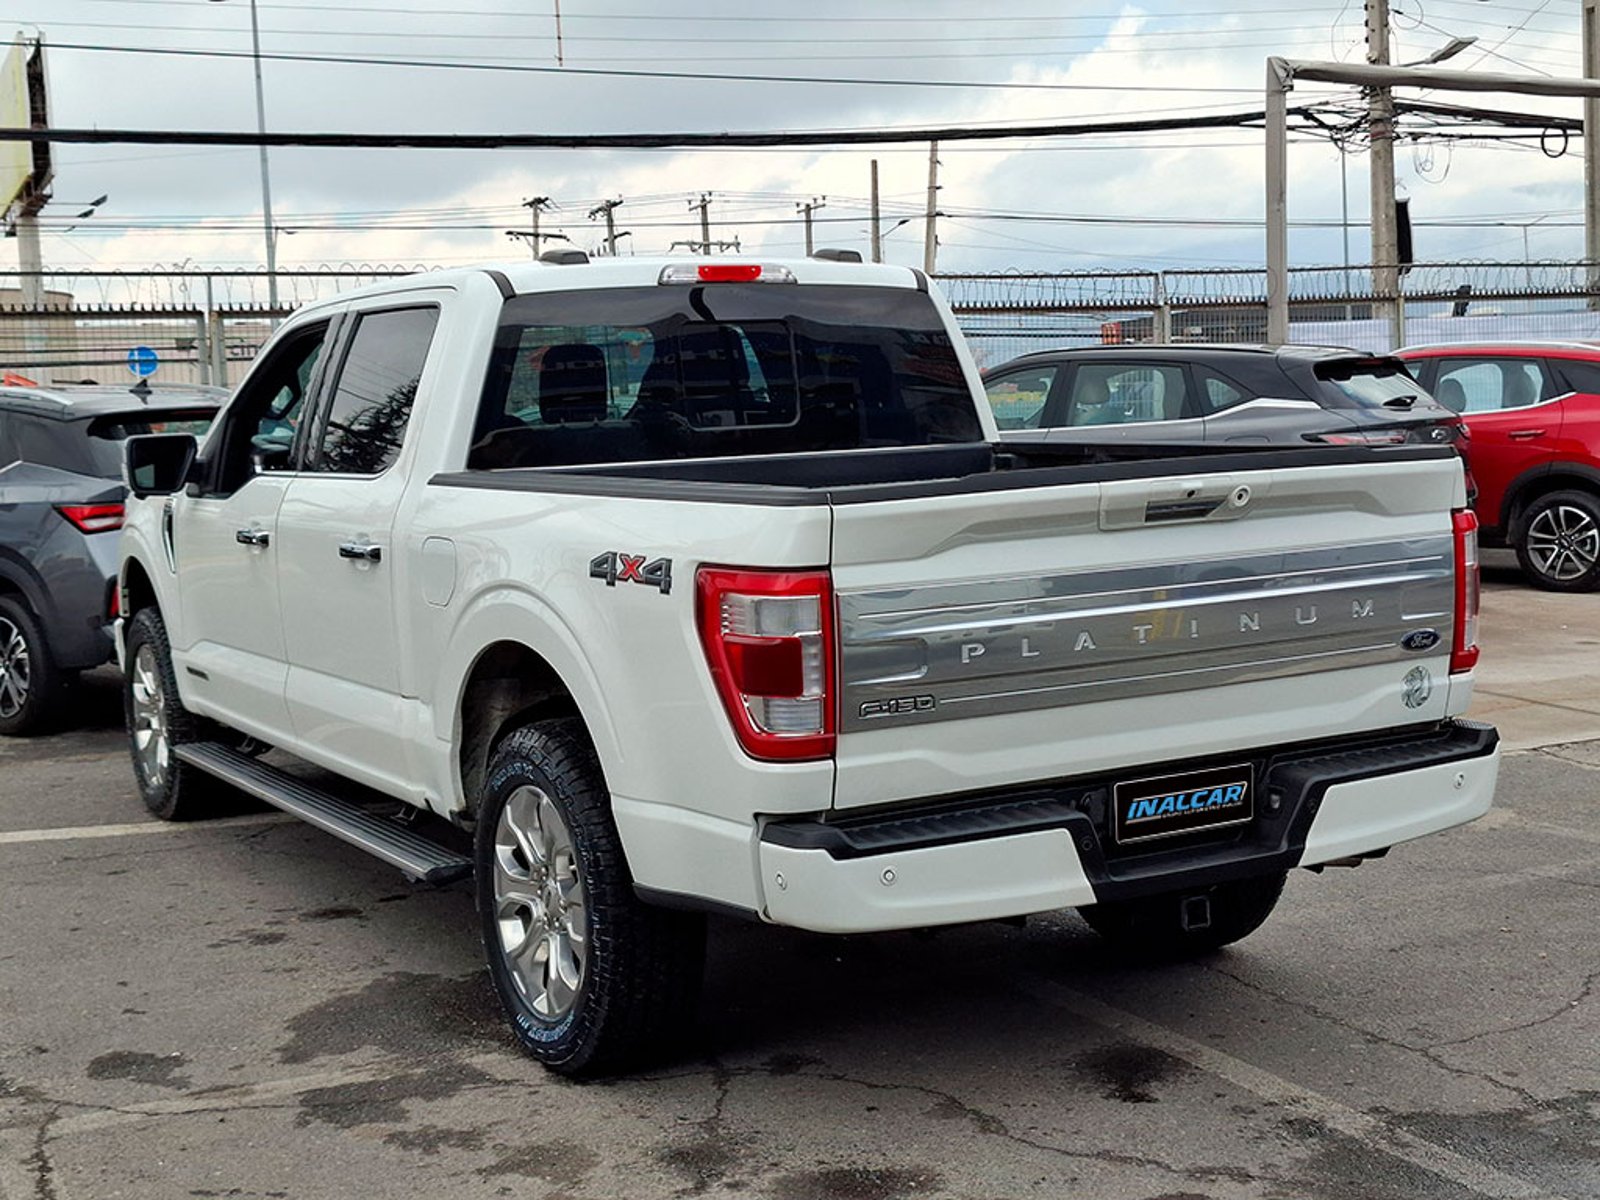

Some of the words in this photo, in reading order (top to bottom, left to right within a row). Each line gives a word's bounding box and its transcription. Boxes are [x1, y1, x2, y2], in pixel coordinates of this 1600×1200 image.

[961, 600, 1374, 664] PLATINUM
[1407, 631, 1436, 649] Ford
[859, 695, 936, 718] F-150
[1126, 785, 1243, 820] INALCAR
